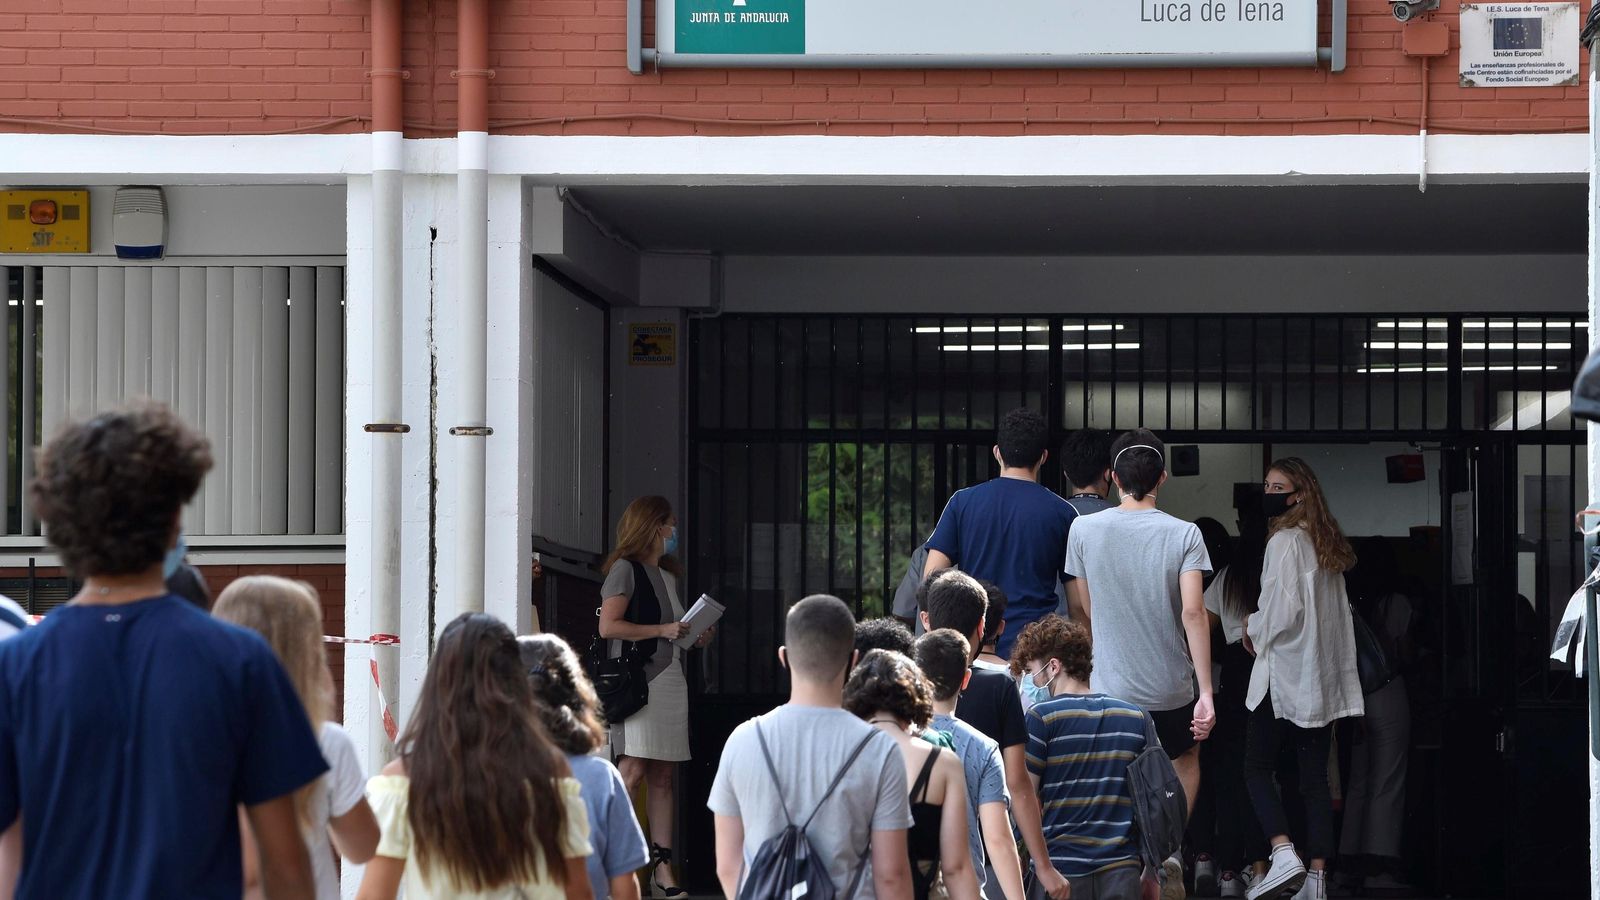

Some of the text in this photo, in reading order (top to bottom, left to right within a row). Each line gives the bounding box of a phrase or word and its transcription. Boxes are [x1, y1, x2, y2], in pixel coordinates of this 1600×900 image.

[1141, 0, 1191, 22] Luca
[1200, 0, 1226, 22] de
[690, 12, 789, 23] JUNTA DE ANDALUCIA
[1517, 62, 1556, 70] profesionales
[1524, 76, 1549, 84] Europeo
